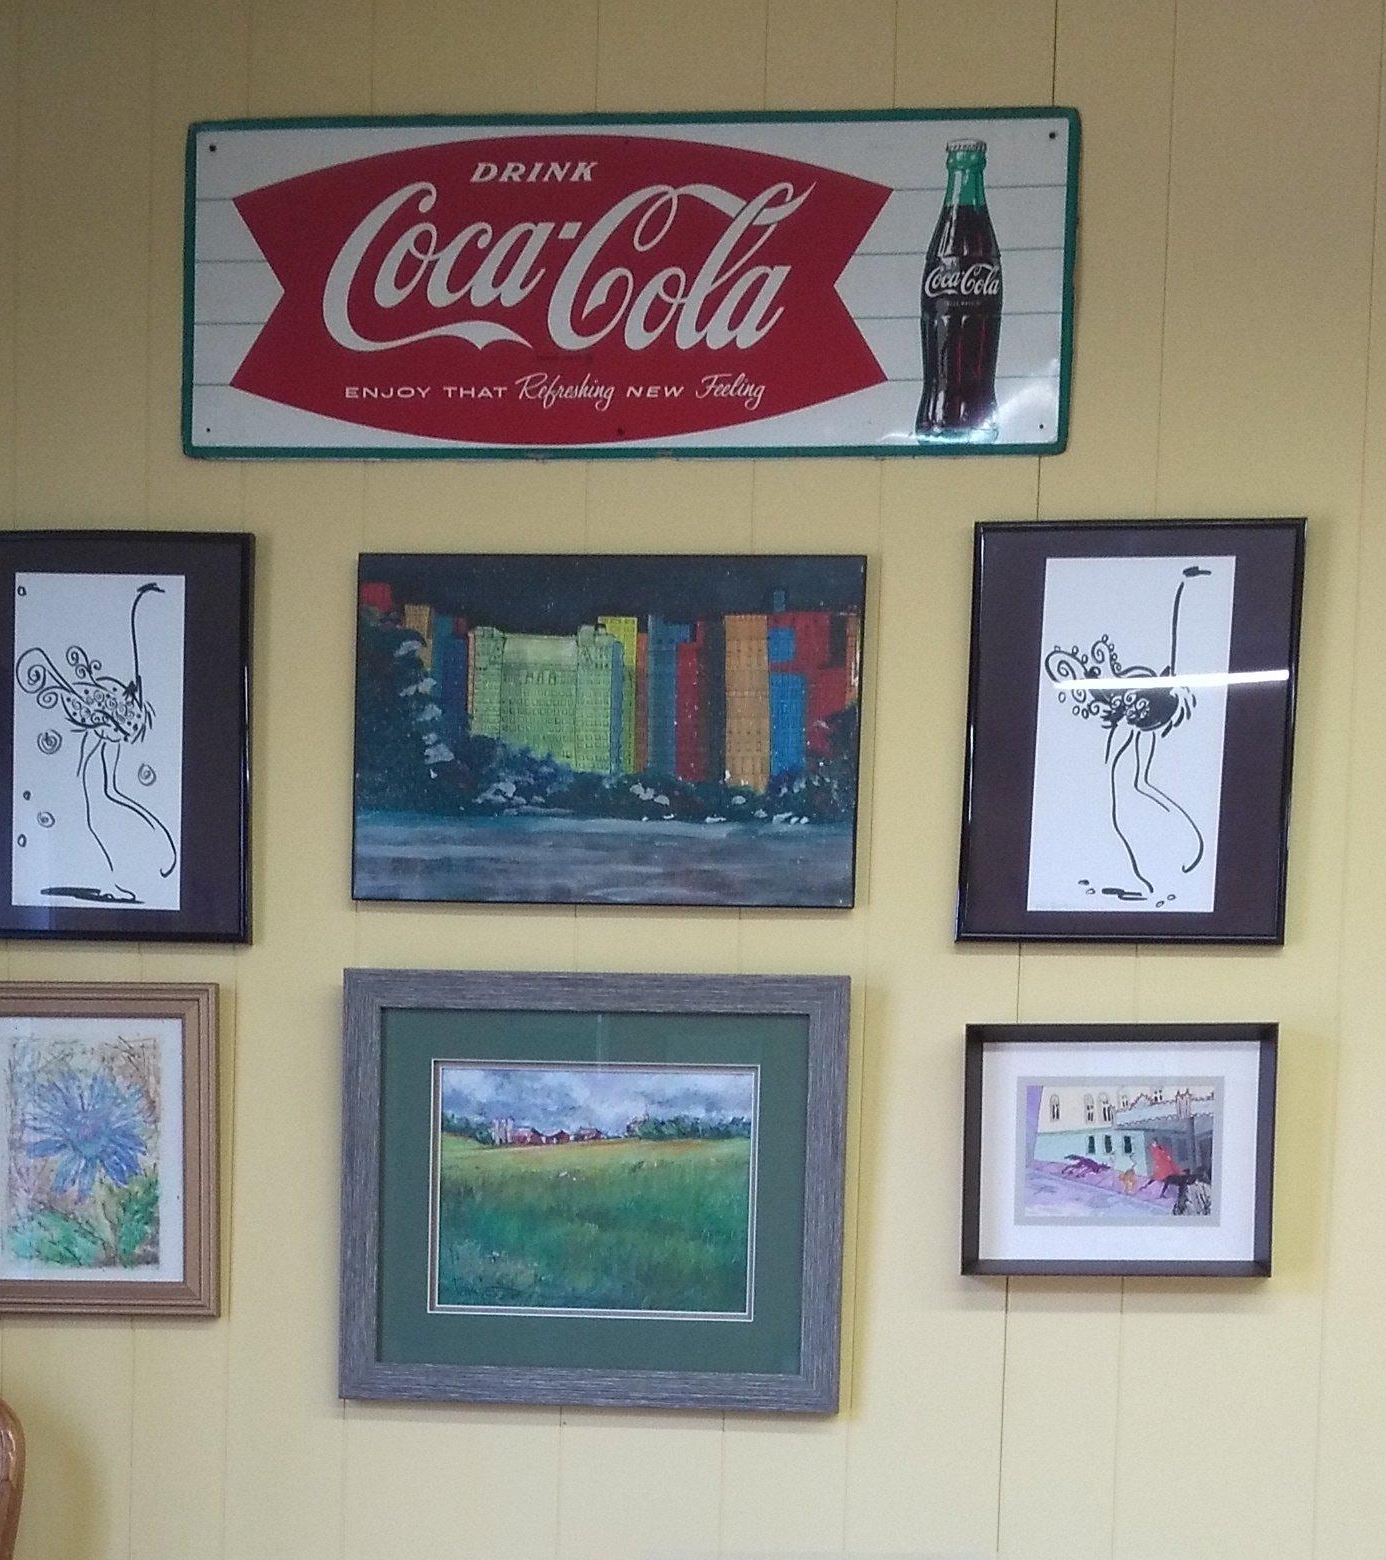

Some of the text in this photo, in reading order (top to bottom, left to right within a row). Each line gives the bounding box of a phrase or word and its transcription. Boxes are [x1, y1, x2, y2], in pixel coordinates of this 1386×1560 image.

[470, 161, 599, 183] DRINK
[323, 180, 817, 352] Coca-Cola
[924, 263, 1001, 298] Coca-Cola
[345, 372, 766, 412] ENJOY THAT Refreshing NEW Feeling
